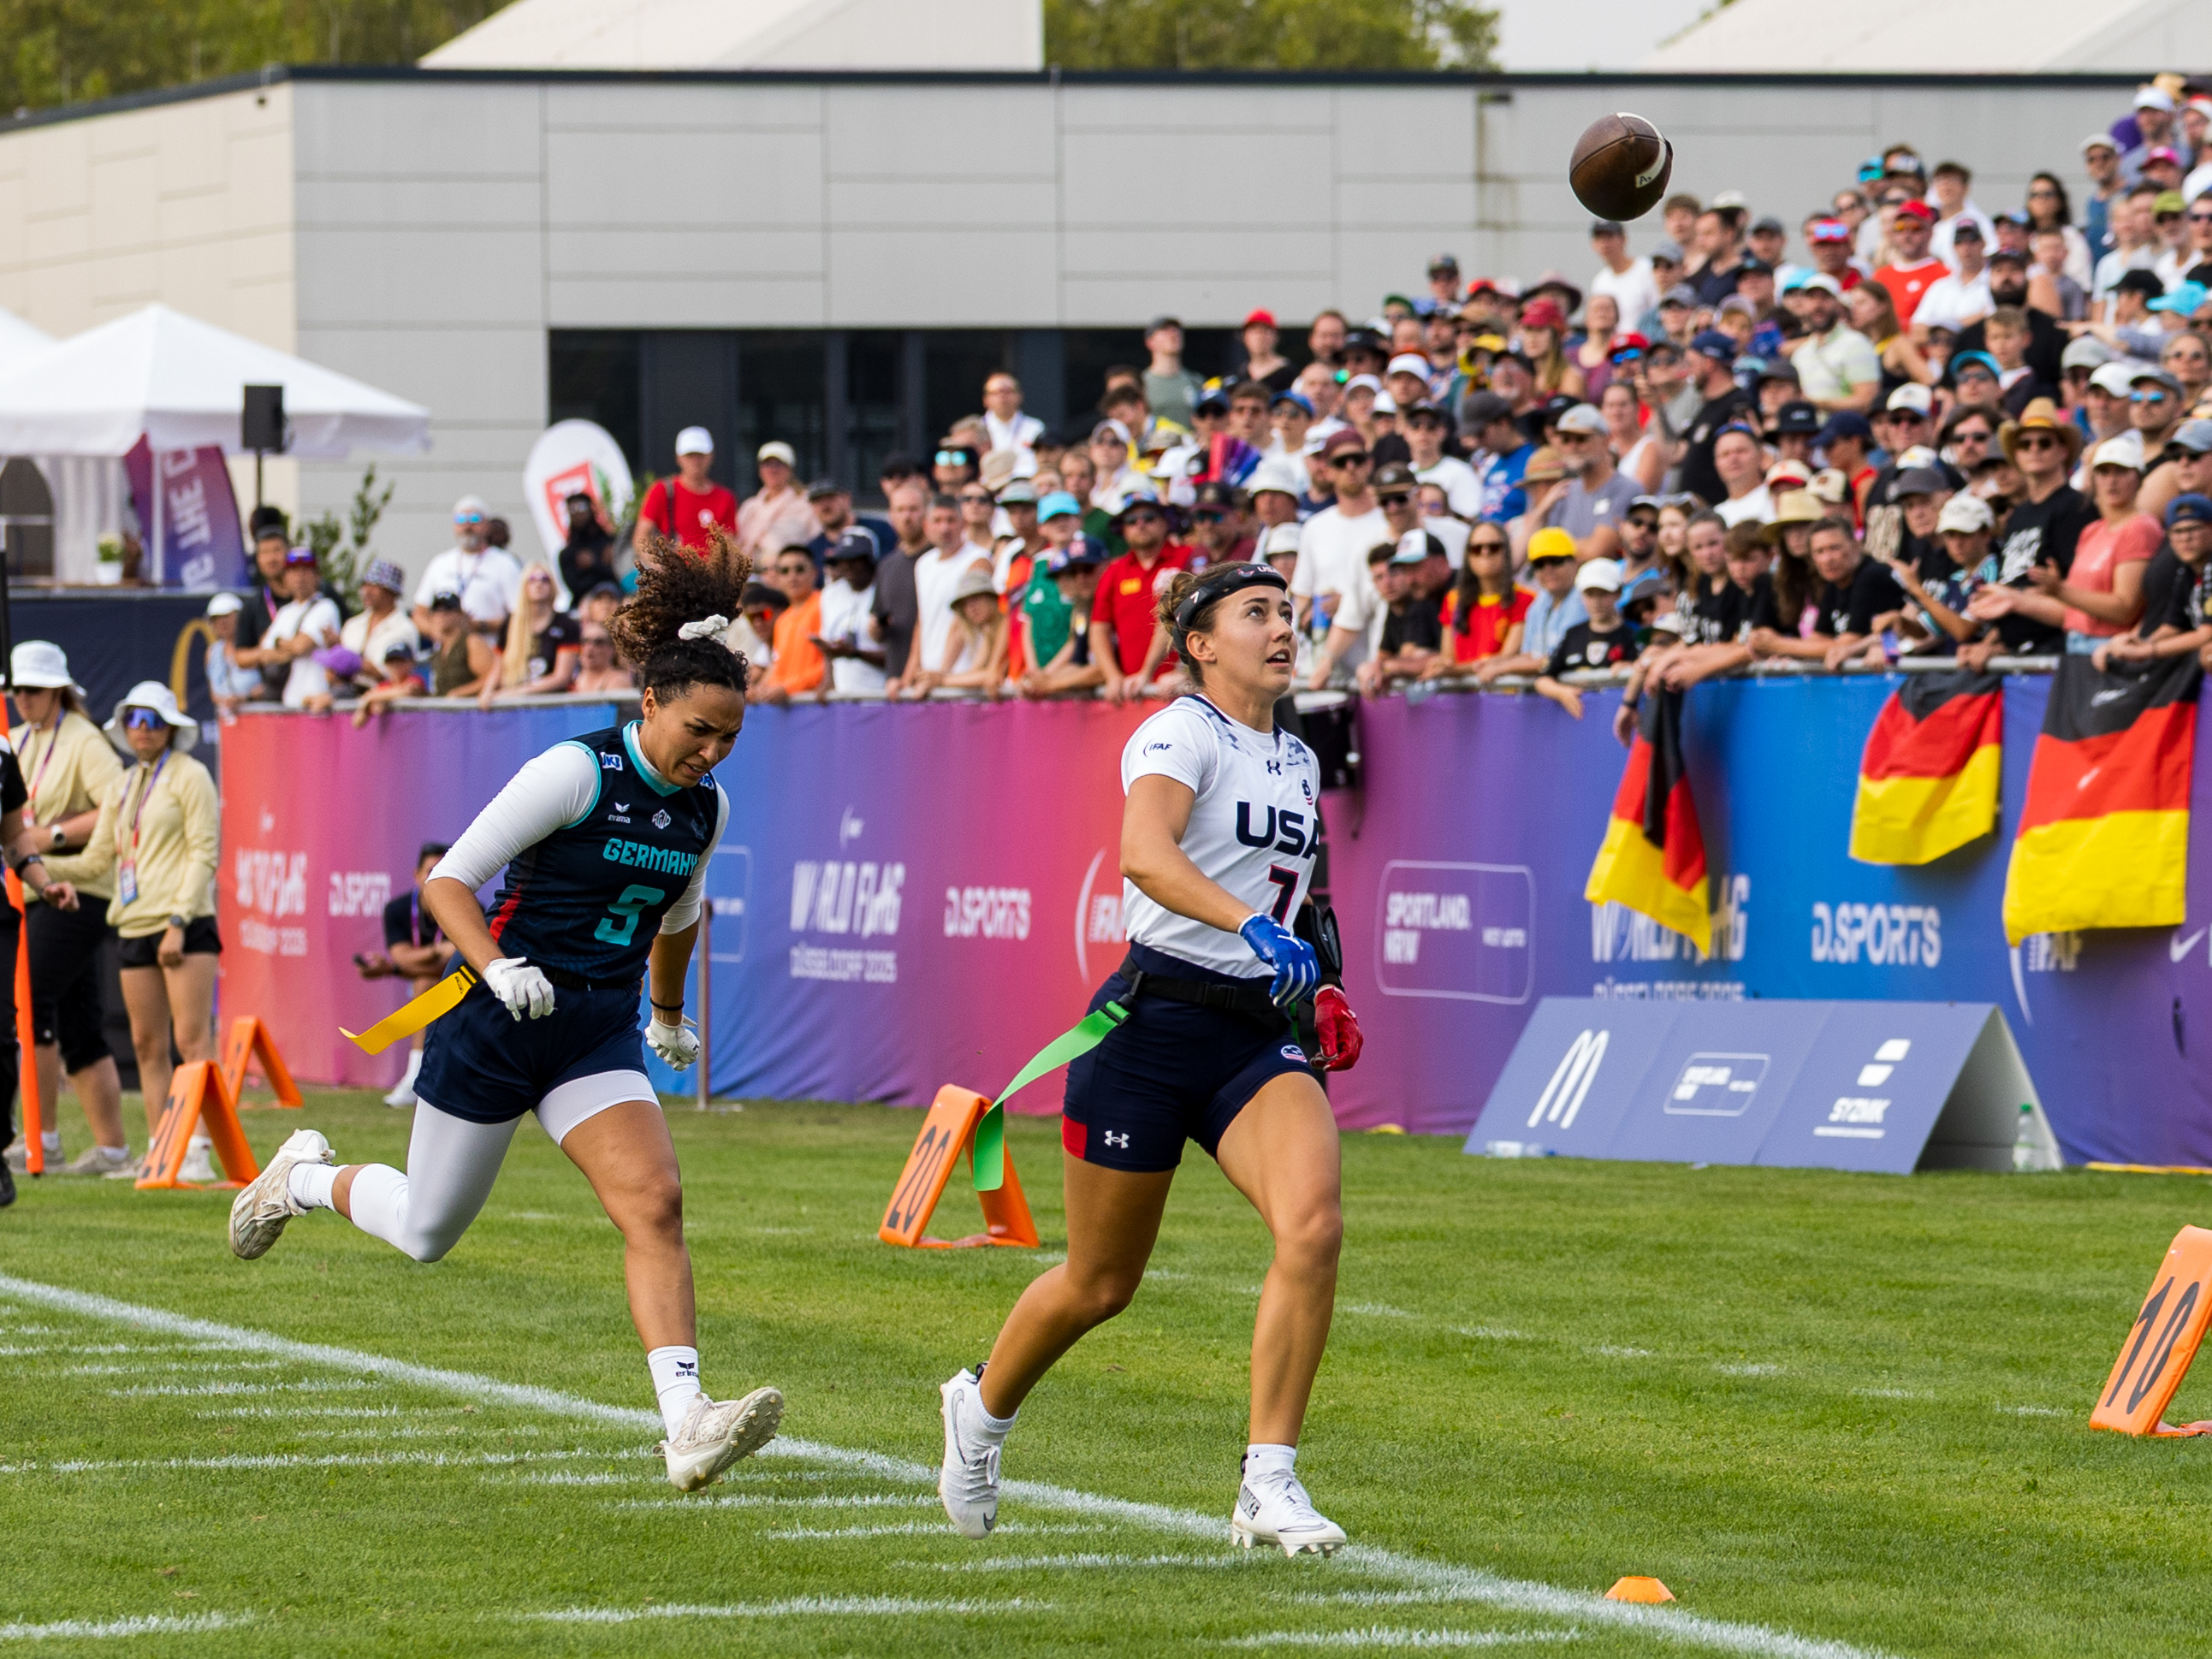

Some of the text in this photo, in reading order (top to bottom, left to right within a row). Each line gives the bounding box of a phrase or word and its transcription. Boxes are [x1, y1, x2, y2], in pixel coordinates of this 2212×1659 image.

[602, 838, 698, 877] GERMANY
[1268, 864, 1299, 927] 7
[1811, 901, 1942, 969] D.SPORTS
[887, 1124, 951, 1234] 20
[2104, 1276, 2200, 1415] 10
